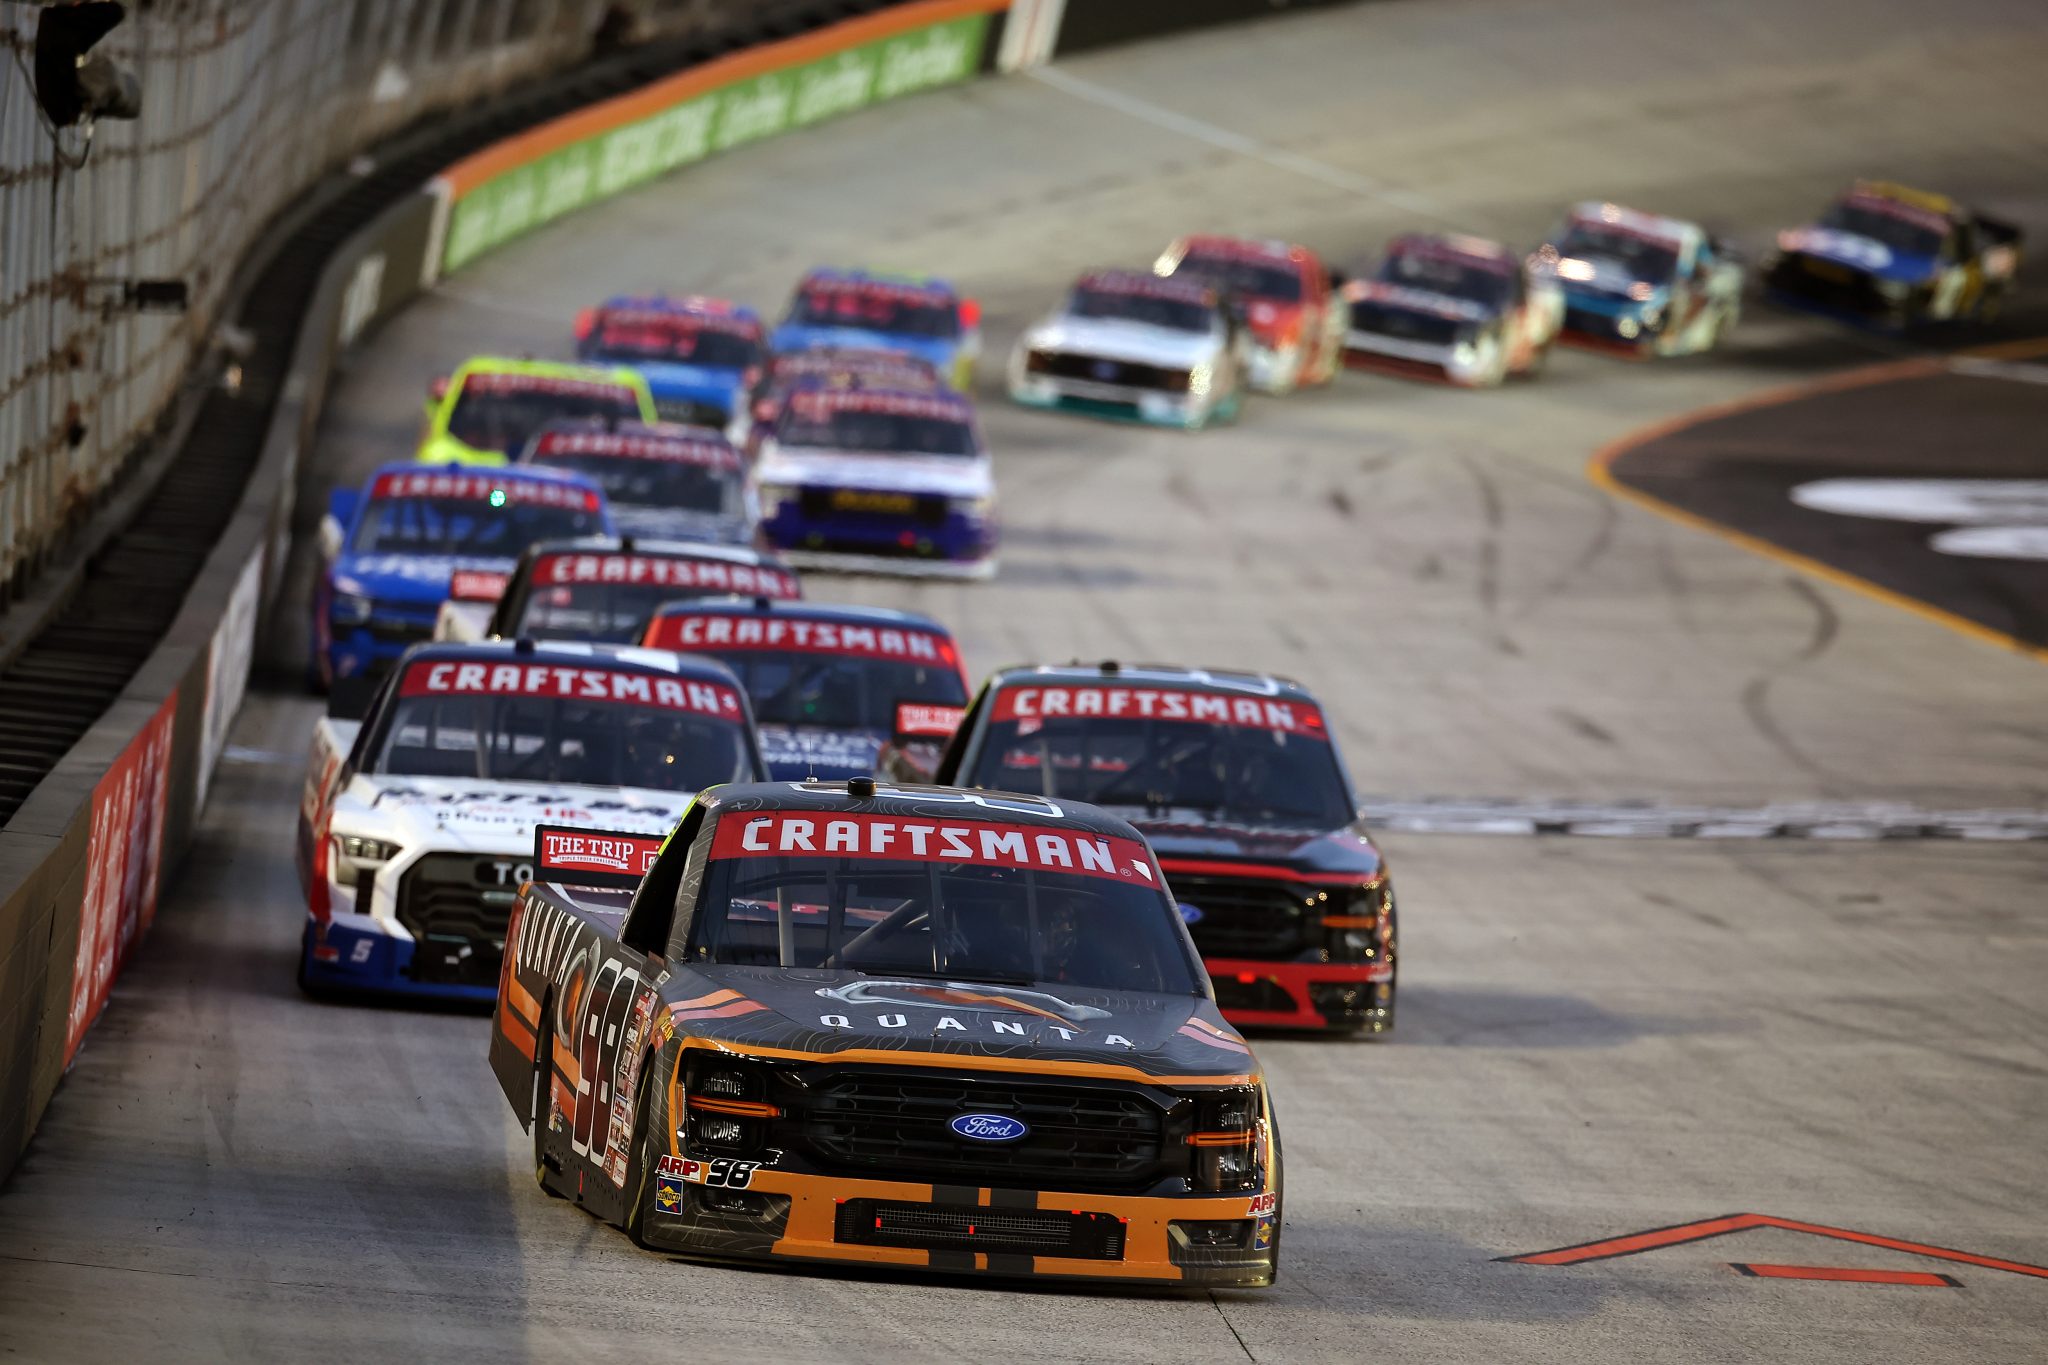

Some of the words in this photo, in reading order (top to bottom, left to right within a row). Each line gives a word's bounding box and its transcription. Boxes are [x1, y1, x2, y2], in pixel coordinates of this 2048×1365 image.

[552, 555, 782, 595] CRAFTSMAN
[680, 618, 937, 660] CRAFTSMAN
[427, 663, 722, 713] CRAFTSMAN
[1013, 688, 1295, 729] CRAFTSMAN
[546, 836, 585, 855] THE
[588, 839, 634, 862] TRIP
[741, 818, 1117, 874] CRAFTSMAN
[516, 895, 586, 986] QUANTA
[819, 1014, 1136, 1049] QUANTA
[964, 1116, 1013, 1136] Ford
[657, 1155, 701, 1177] ARP
[705, 1157, 762, 1190] 98
